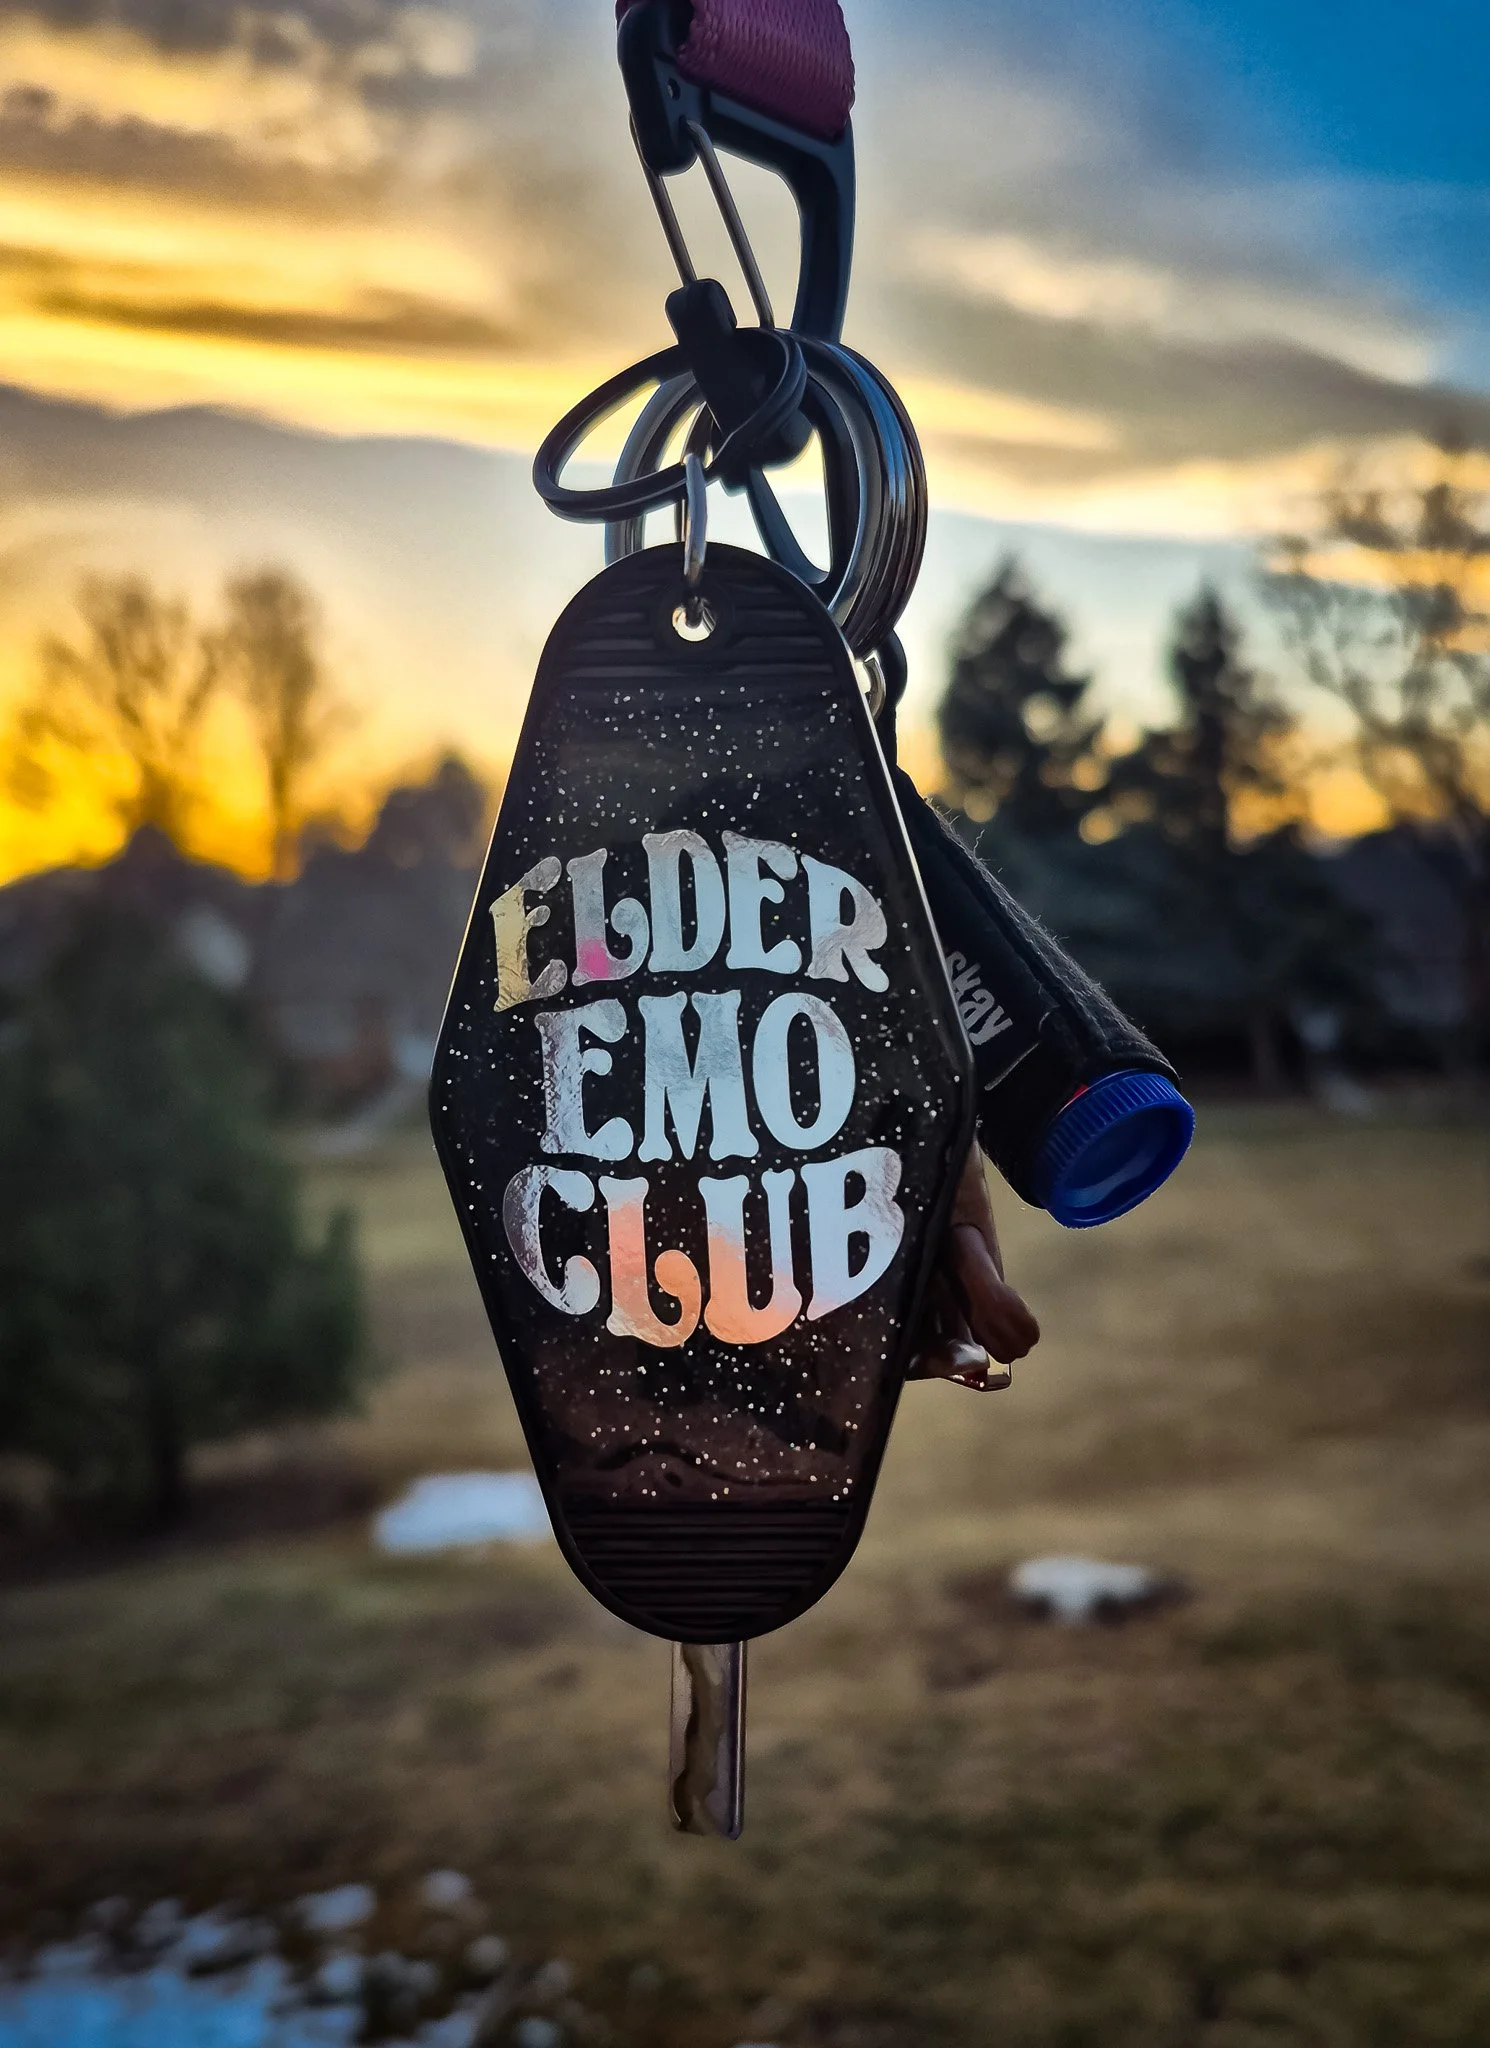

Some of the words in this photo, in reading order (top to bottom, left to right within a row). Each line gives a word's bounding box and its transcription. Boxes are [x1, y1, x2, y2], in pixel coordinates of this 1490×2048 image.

[489, 829, 889, 1012] ELDER
[534, 990, 856, 1162] EMO
[502, 1146, 906, 1349] CLUB
